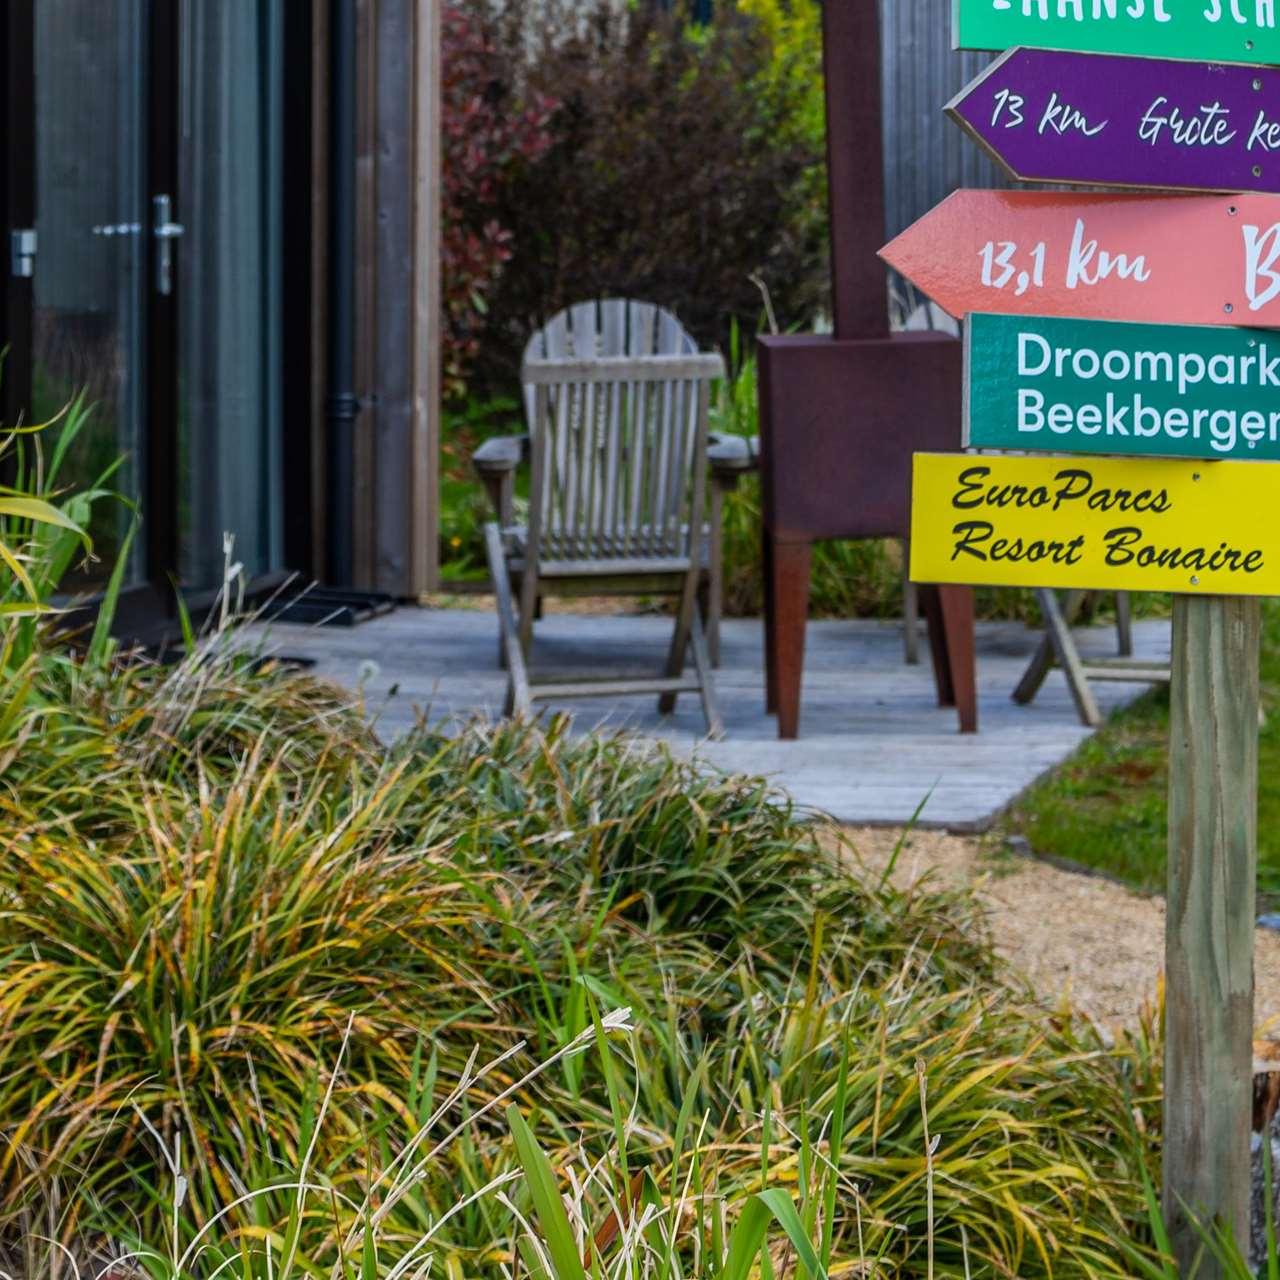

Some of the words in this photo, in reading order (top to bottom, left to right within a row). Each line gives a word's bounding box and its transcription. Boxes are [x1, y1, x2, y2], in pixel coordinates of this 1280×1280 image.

[990, 89, 1023, 128] 13
[1039, 92, 1108, 137] km
[1137, 97, 1237, 147] Grote
[978, 240, 1045, 296] 13,1
[1065, 218, 1151, 291] km
[952, 466, 1172, 513] EuroParcs
[950, 521, 1086, 565] Resort
[1104, 526, 1264, 575] Bonaire
